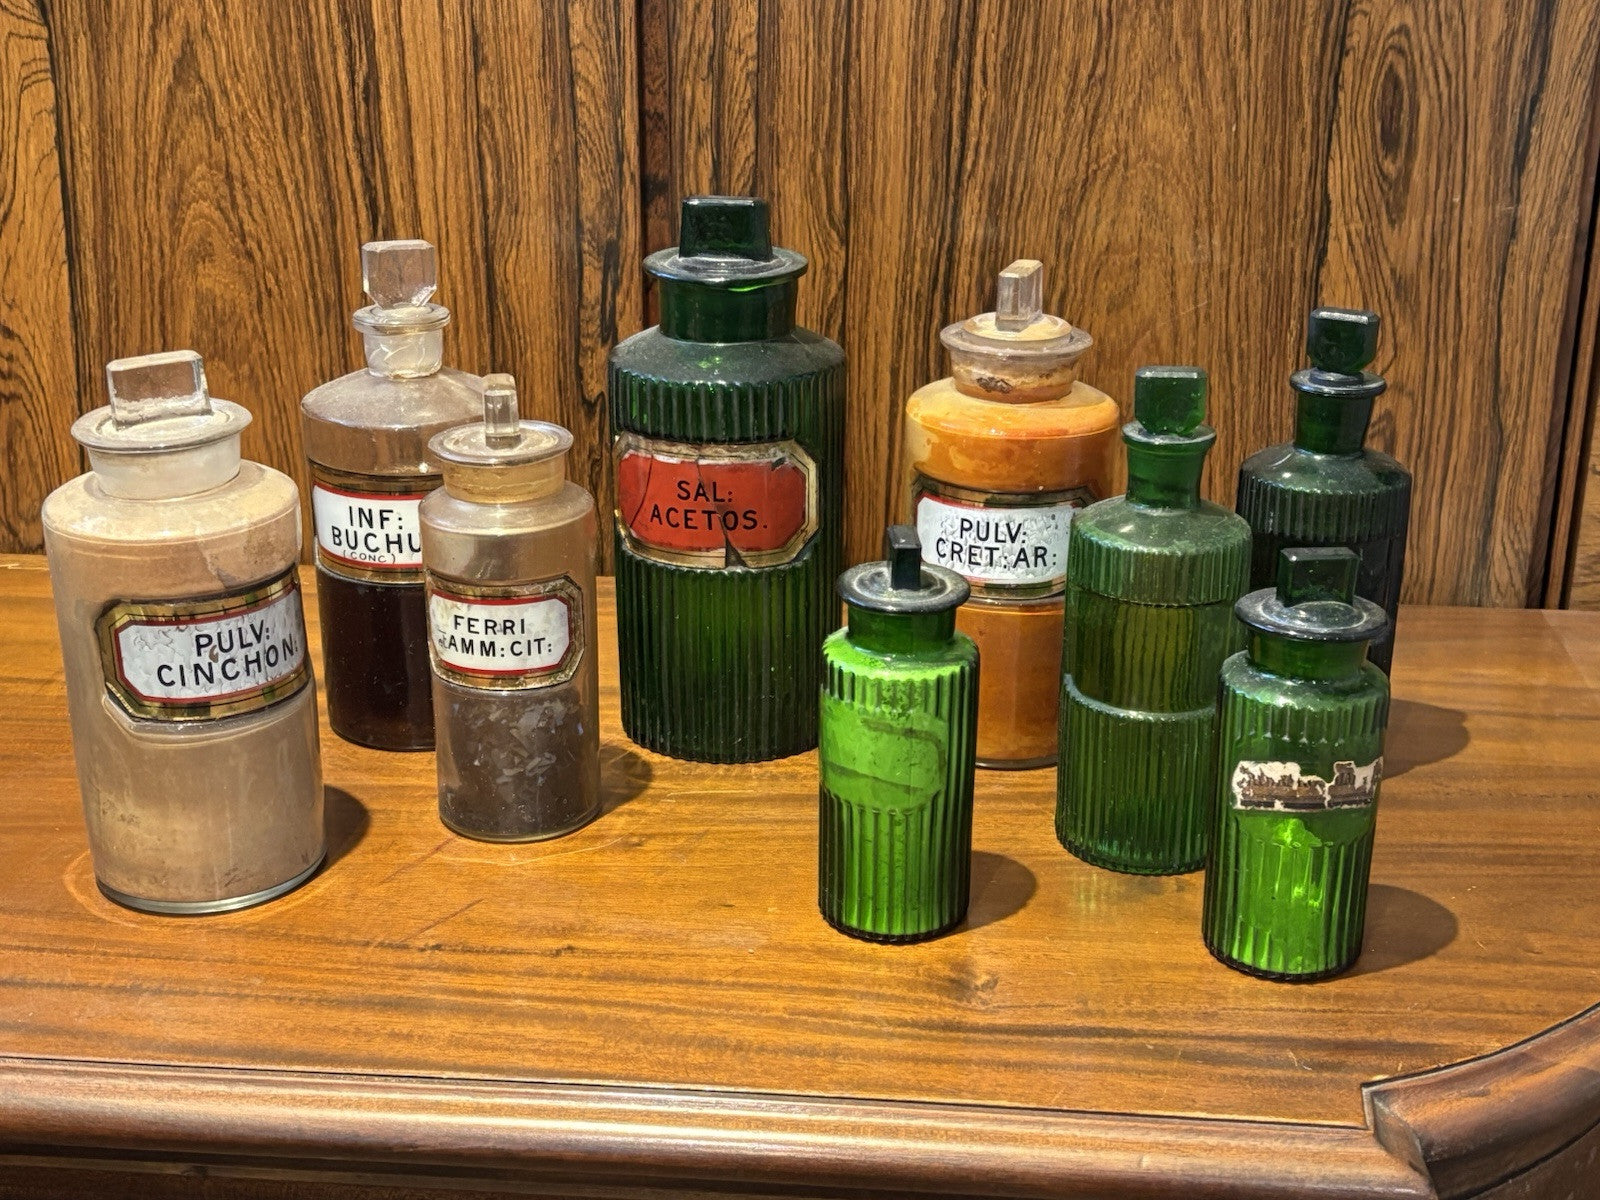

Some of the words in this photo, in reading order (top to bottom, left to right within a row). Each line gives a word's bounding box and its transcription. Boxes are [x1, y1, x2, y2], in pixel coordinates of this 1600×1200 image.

[676, 480, 733, 503] SAL:
[348, 505, 403, 530] INF:
[650, 504, 768, 531] ACETOS.
[960, 517, 1027, 544] PULV:
[453, 614, 525, 635] FERRI
[194, 619, 270, 657] PULV:
